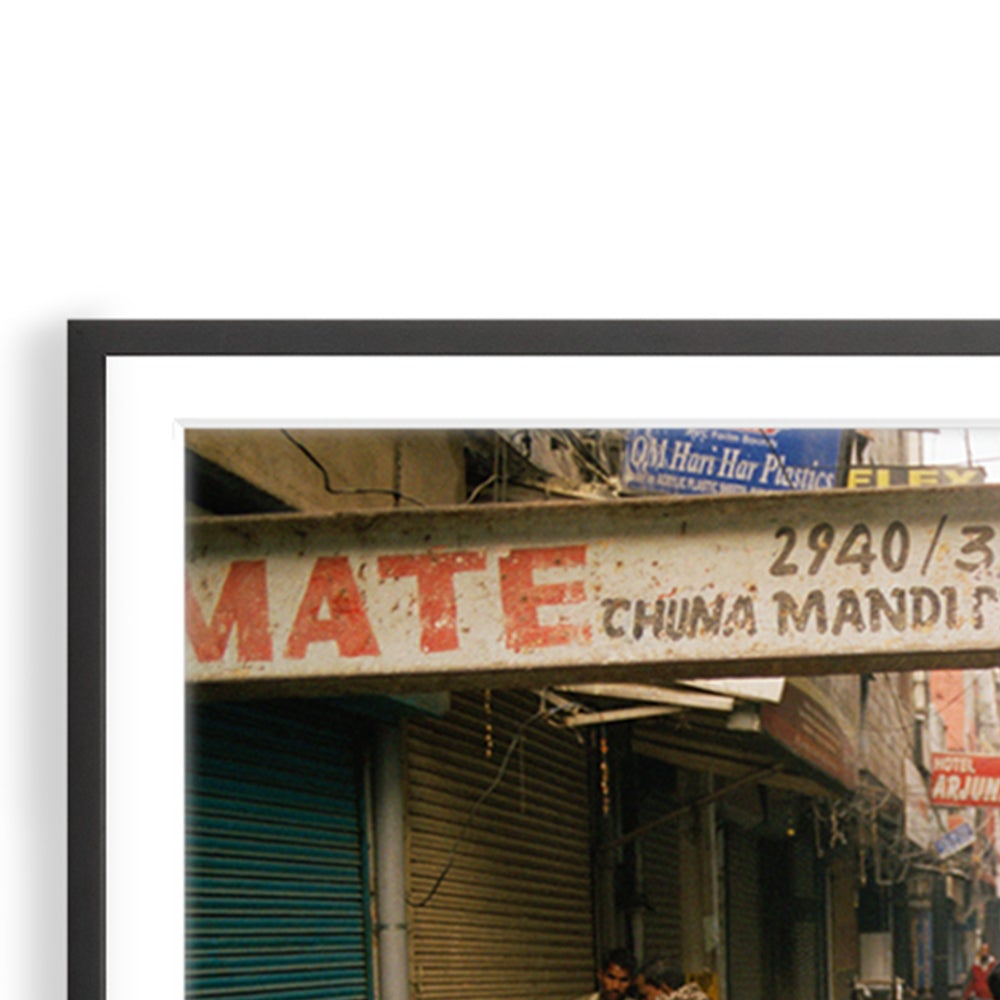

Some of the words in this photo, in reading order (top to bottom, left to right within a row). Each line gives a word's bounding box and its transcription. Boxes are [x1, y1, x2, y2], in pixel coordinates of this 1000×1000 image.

[669, 441, 717, 475] Hari
[716, 447, 760, 478] Har
[757, 453, 836, 489] Plastics
[769, 514, 996, 577] 2940/3
[185, 547, 594, 662] MATE
[601, 594, 757, 641] CHUNA
[773, 587, 960, 637] MANDI
[933, 757, 976, 774] HOTEL
